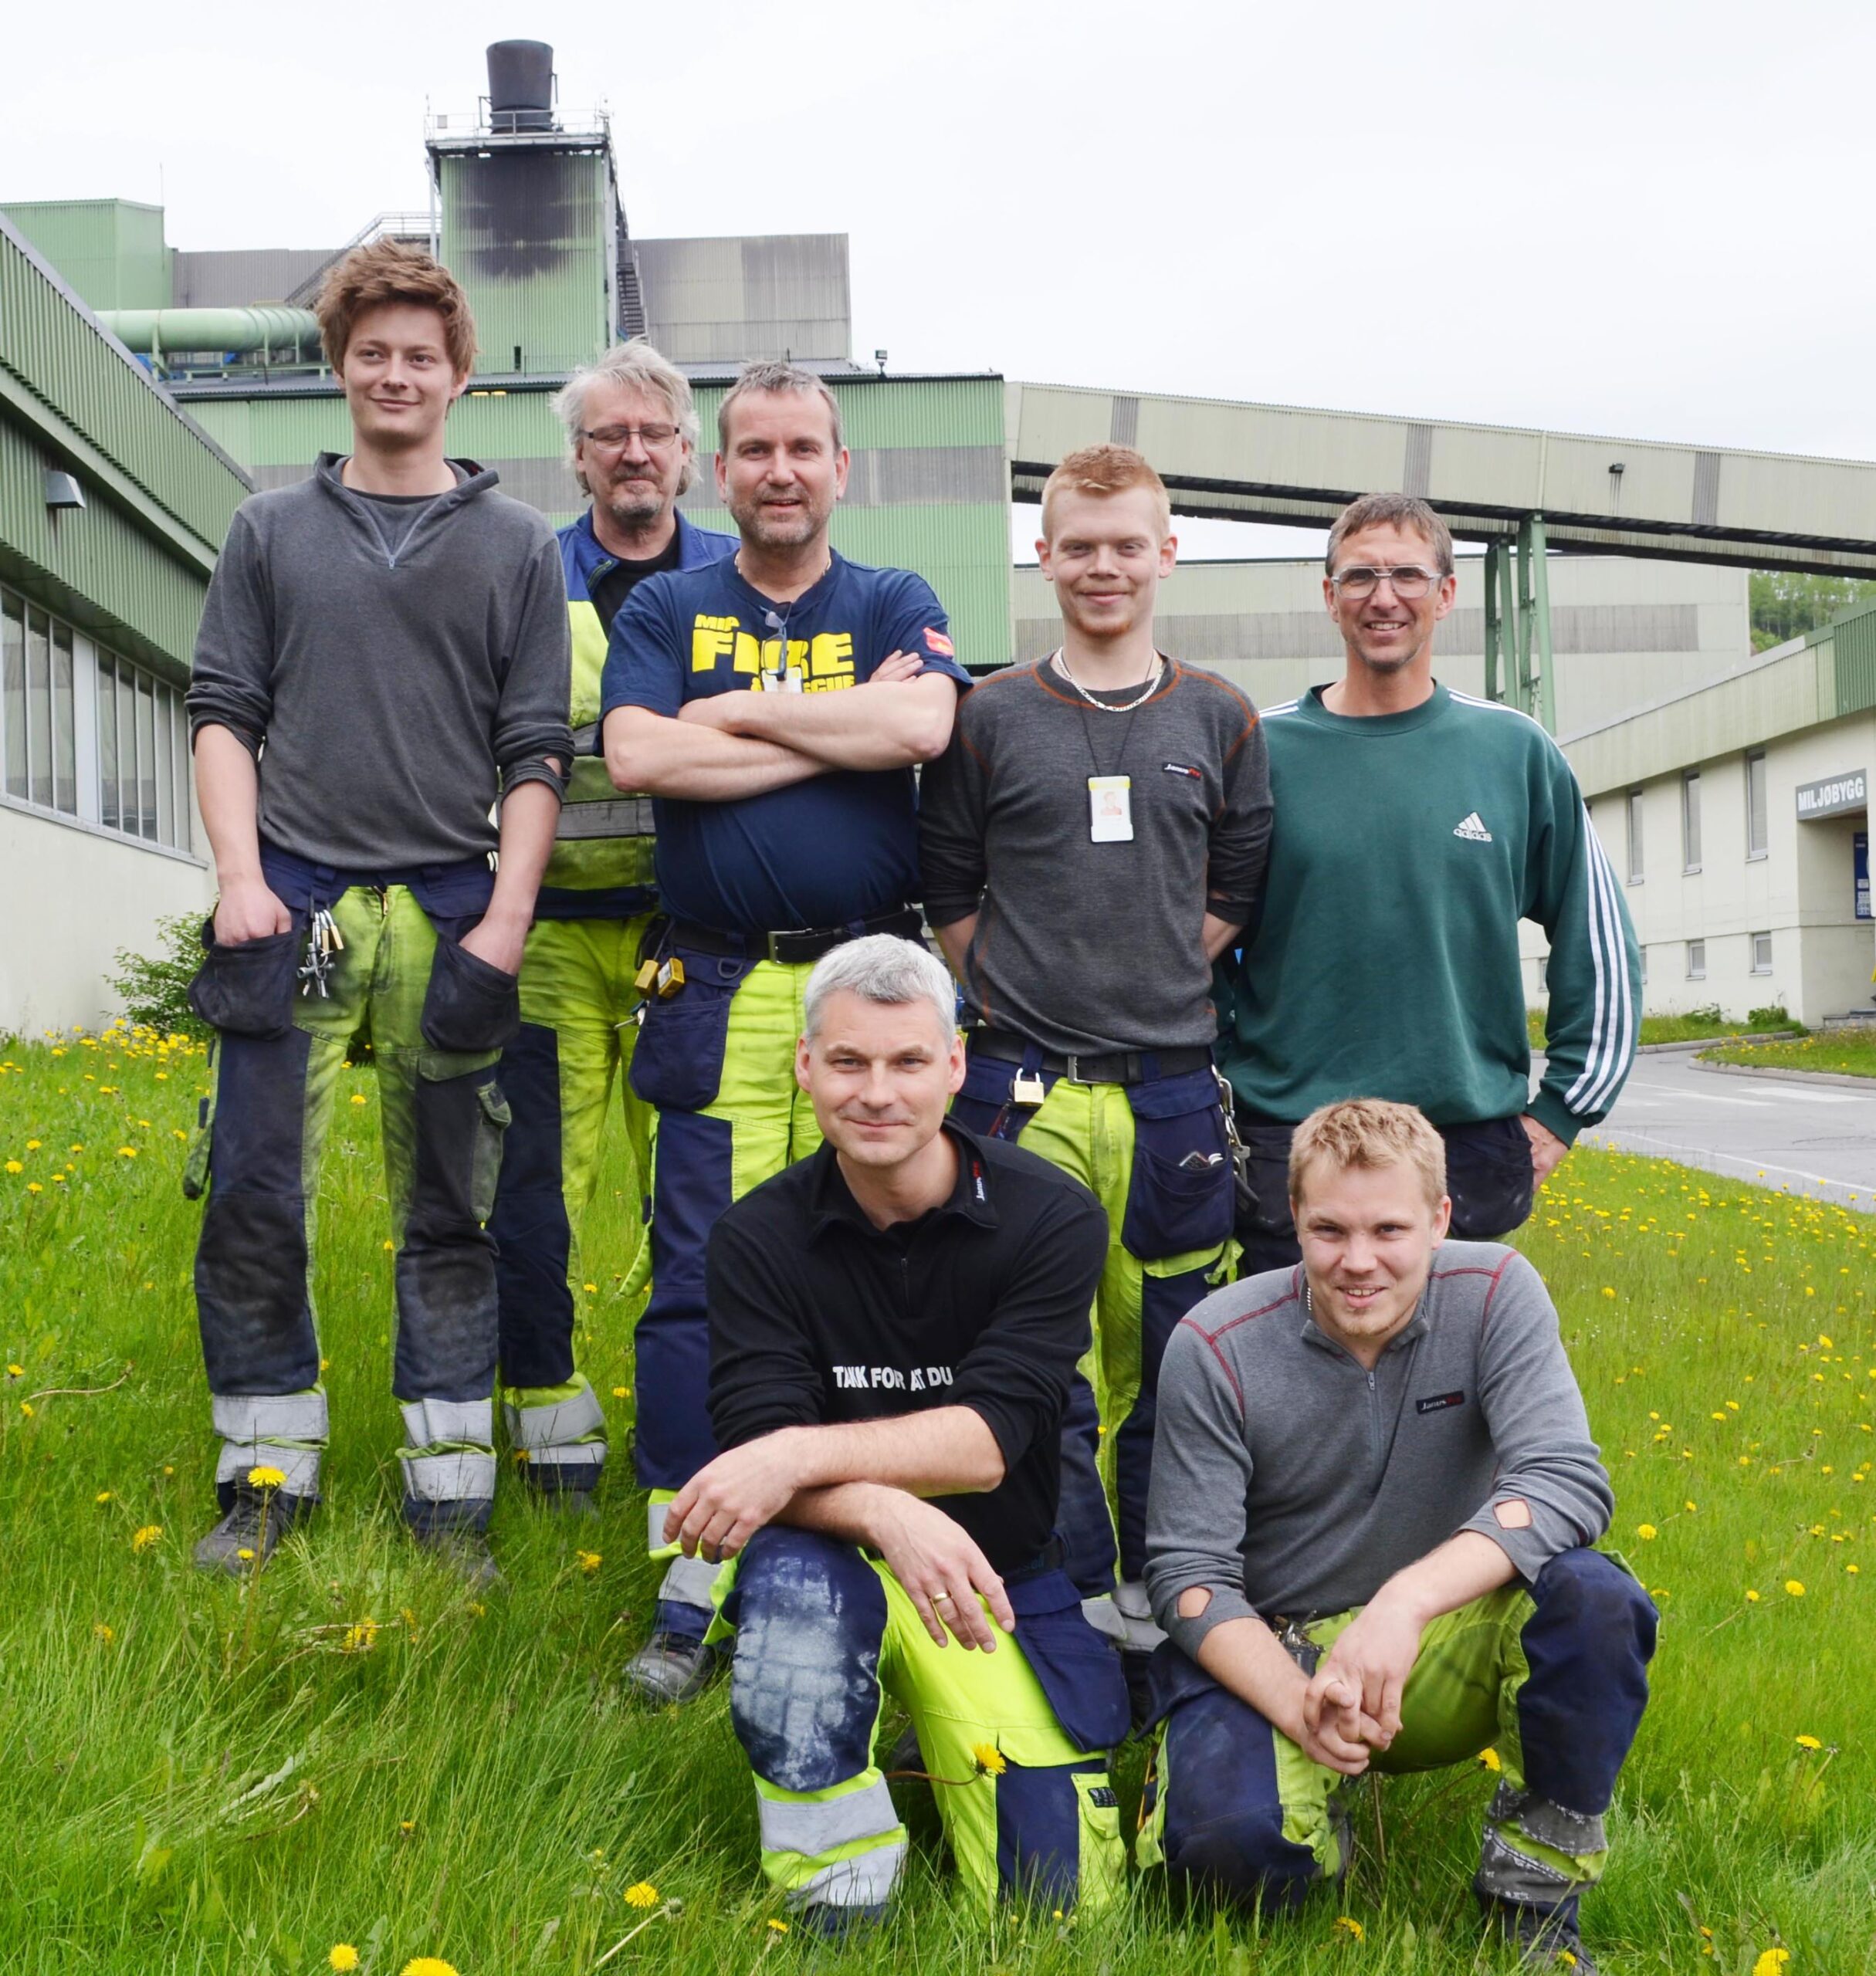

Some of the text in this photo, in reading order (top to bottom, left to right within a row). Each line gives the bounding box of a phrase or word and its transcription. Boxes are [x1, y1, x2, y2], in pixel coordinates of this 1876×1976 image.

[1797, 777, 1864, 812] MILJØBYGG
[1453, 828, 1492, 842] adidas
[870, 1366, 906, 1391] FOR
[909, 1368, 926, 1392] AT
[926, 1366, 953, 1387] DU
